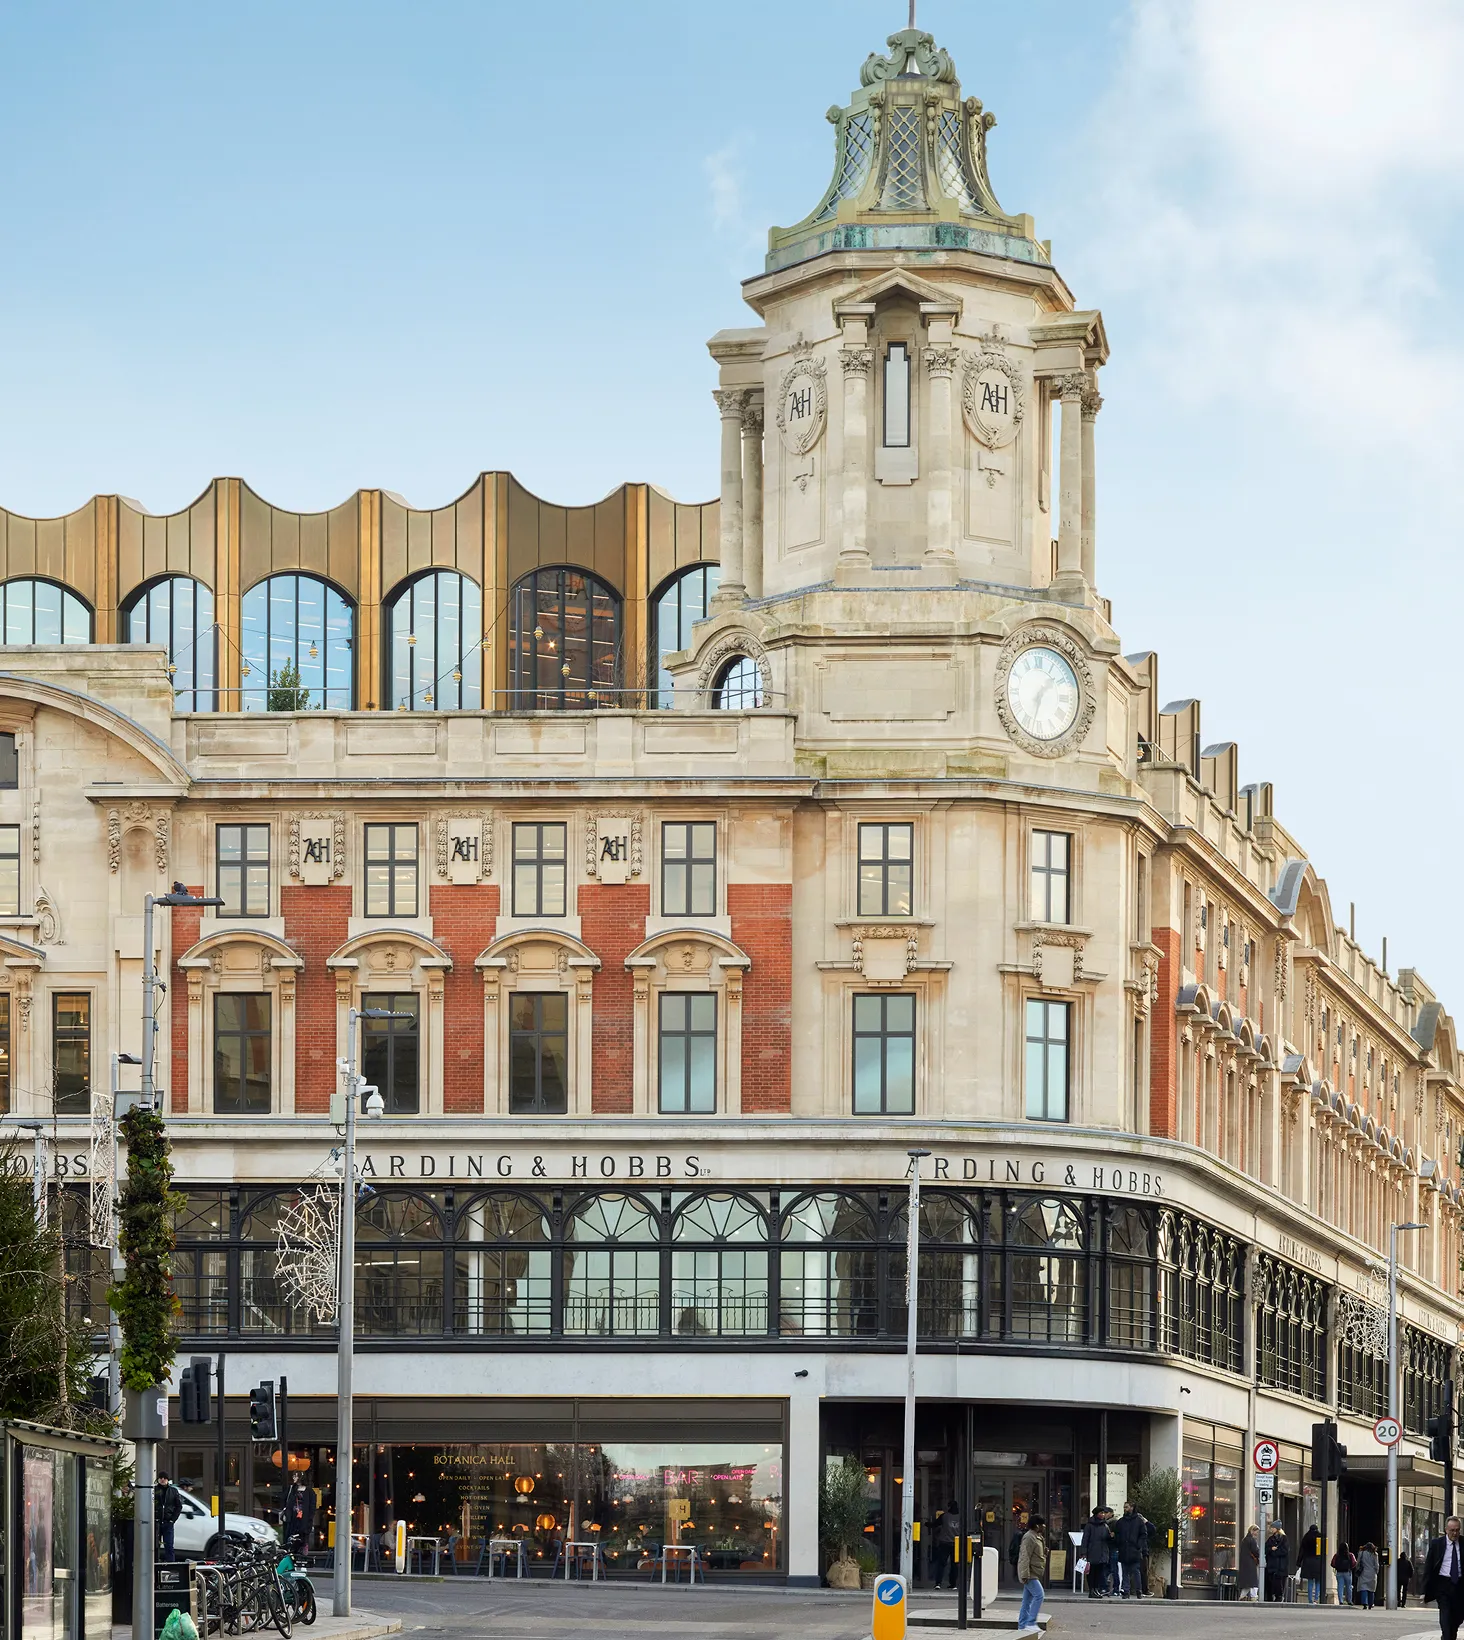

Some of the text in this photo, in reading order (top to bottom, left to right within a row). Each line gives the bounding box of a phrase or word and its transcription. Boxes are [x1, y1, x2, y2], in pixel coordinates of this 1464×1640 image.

[361, 1155, 512, 1177] ARDING
[531, 1155, 548, 1177] &
[571, 1155, 699, 1177] HOBBS
[1064, 1164, 1077, 1187] &
[1093, 1167, 1163, 1197] HOBBS
[1378, 1426, 1398, 1438] 20
[433, 1455, 515, 1465] BOTANICA HALL
[664, 1469, 700, 1485] BAR
